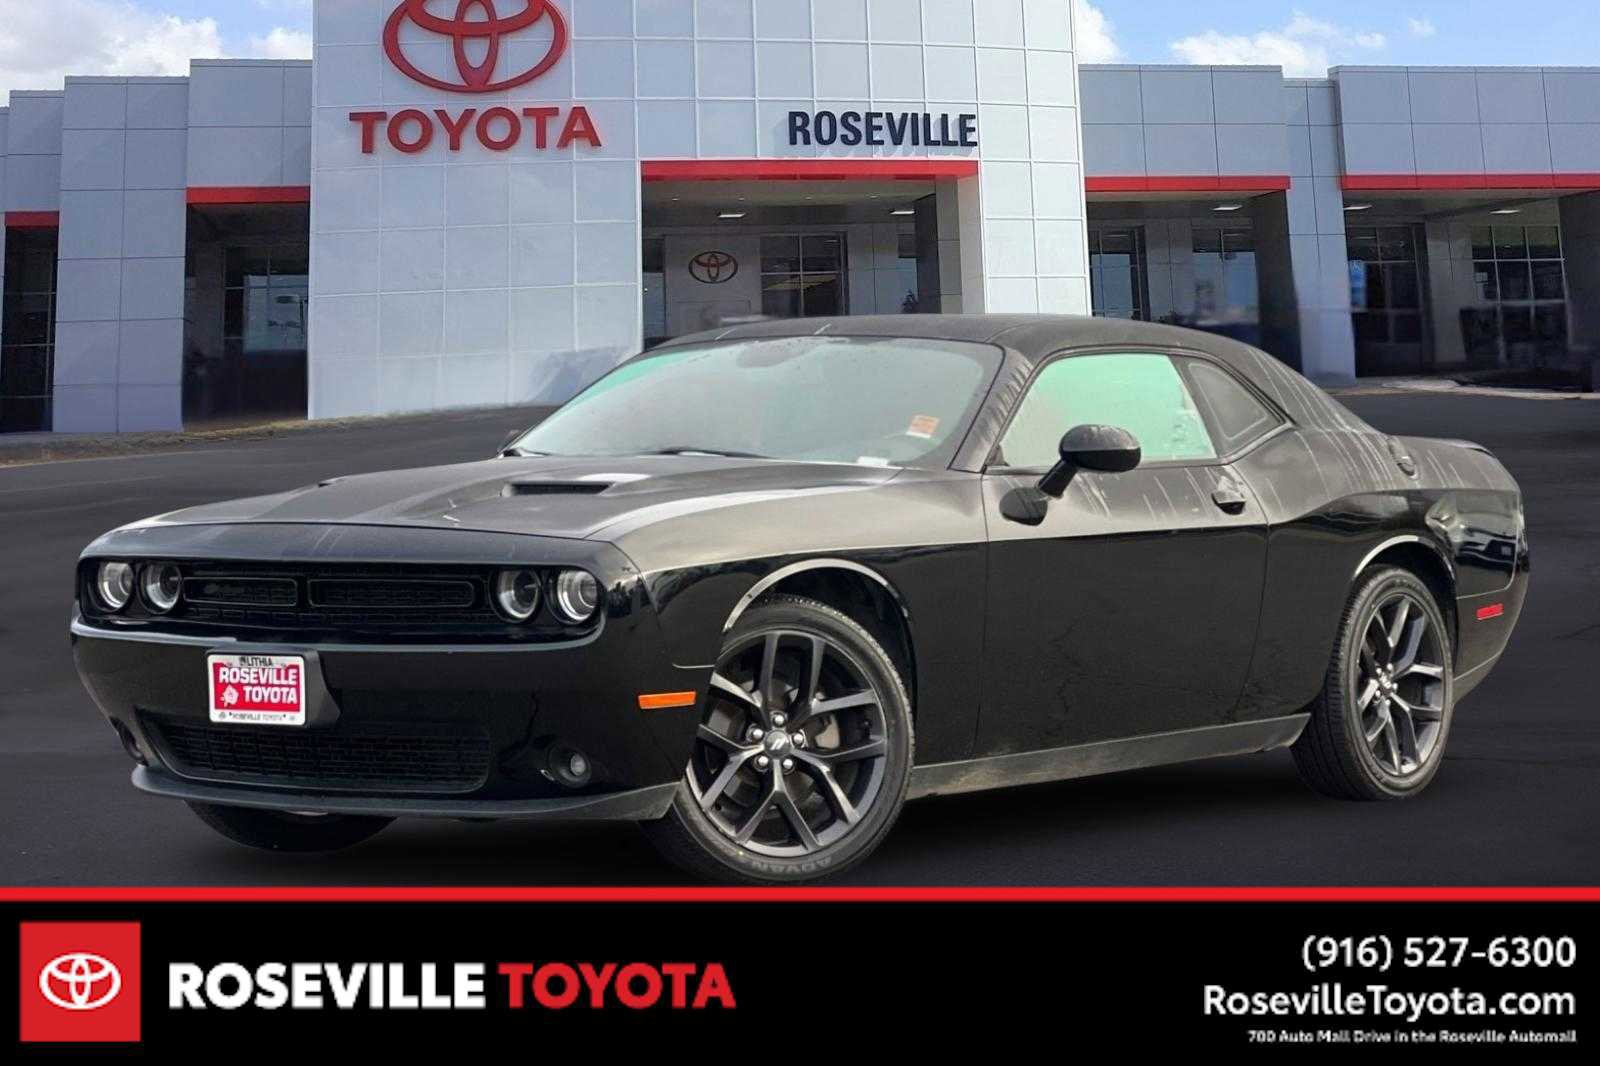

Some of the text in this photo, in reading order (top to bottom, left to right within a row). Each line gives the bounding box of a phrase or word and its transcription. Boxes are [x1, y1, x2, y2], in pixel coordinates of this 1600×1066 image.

[349, 106, 602, 154] TOYOTA
[788, 110, 978, 148] ROSEVILLE
[248, 657, 272, 667] LITHIA
[219, 667, 297, 685] ROSEVILLE
[243, 686, 298, 704] TOYOTA
